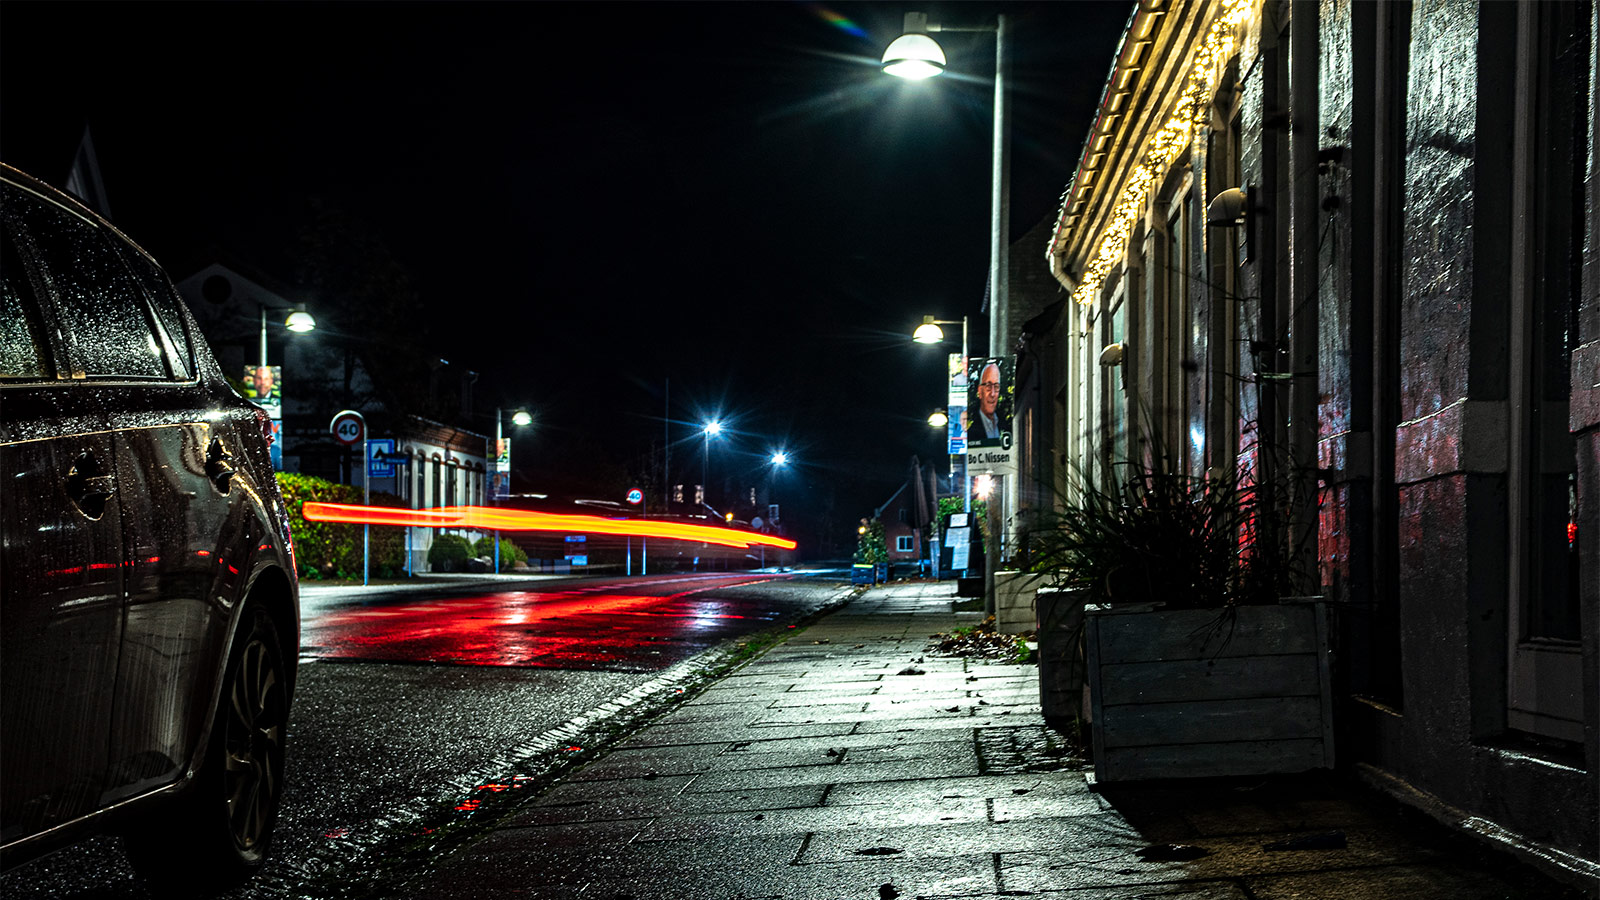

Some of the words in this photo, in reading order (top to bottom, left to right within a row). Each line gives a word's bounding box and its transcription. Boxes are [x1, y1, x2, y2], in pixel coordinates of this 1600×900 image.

[339, 424, 359, 436] 40
[1003, 435, 1010, 447] C
[968, 454, 977, 464] Bo
[985, 452, 1010, 463] Nissen
[629, 492, 641, 500] 40
